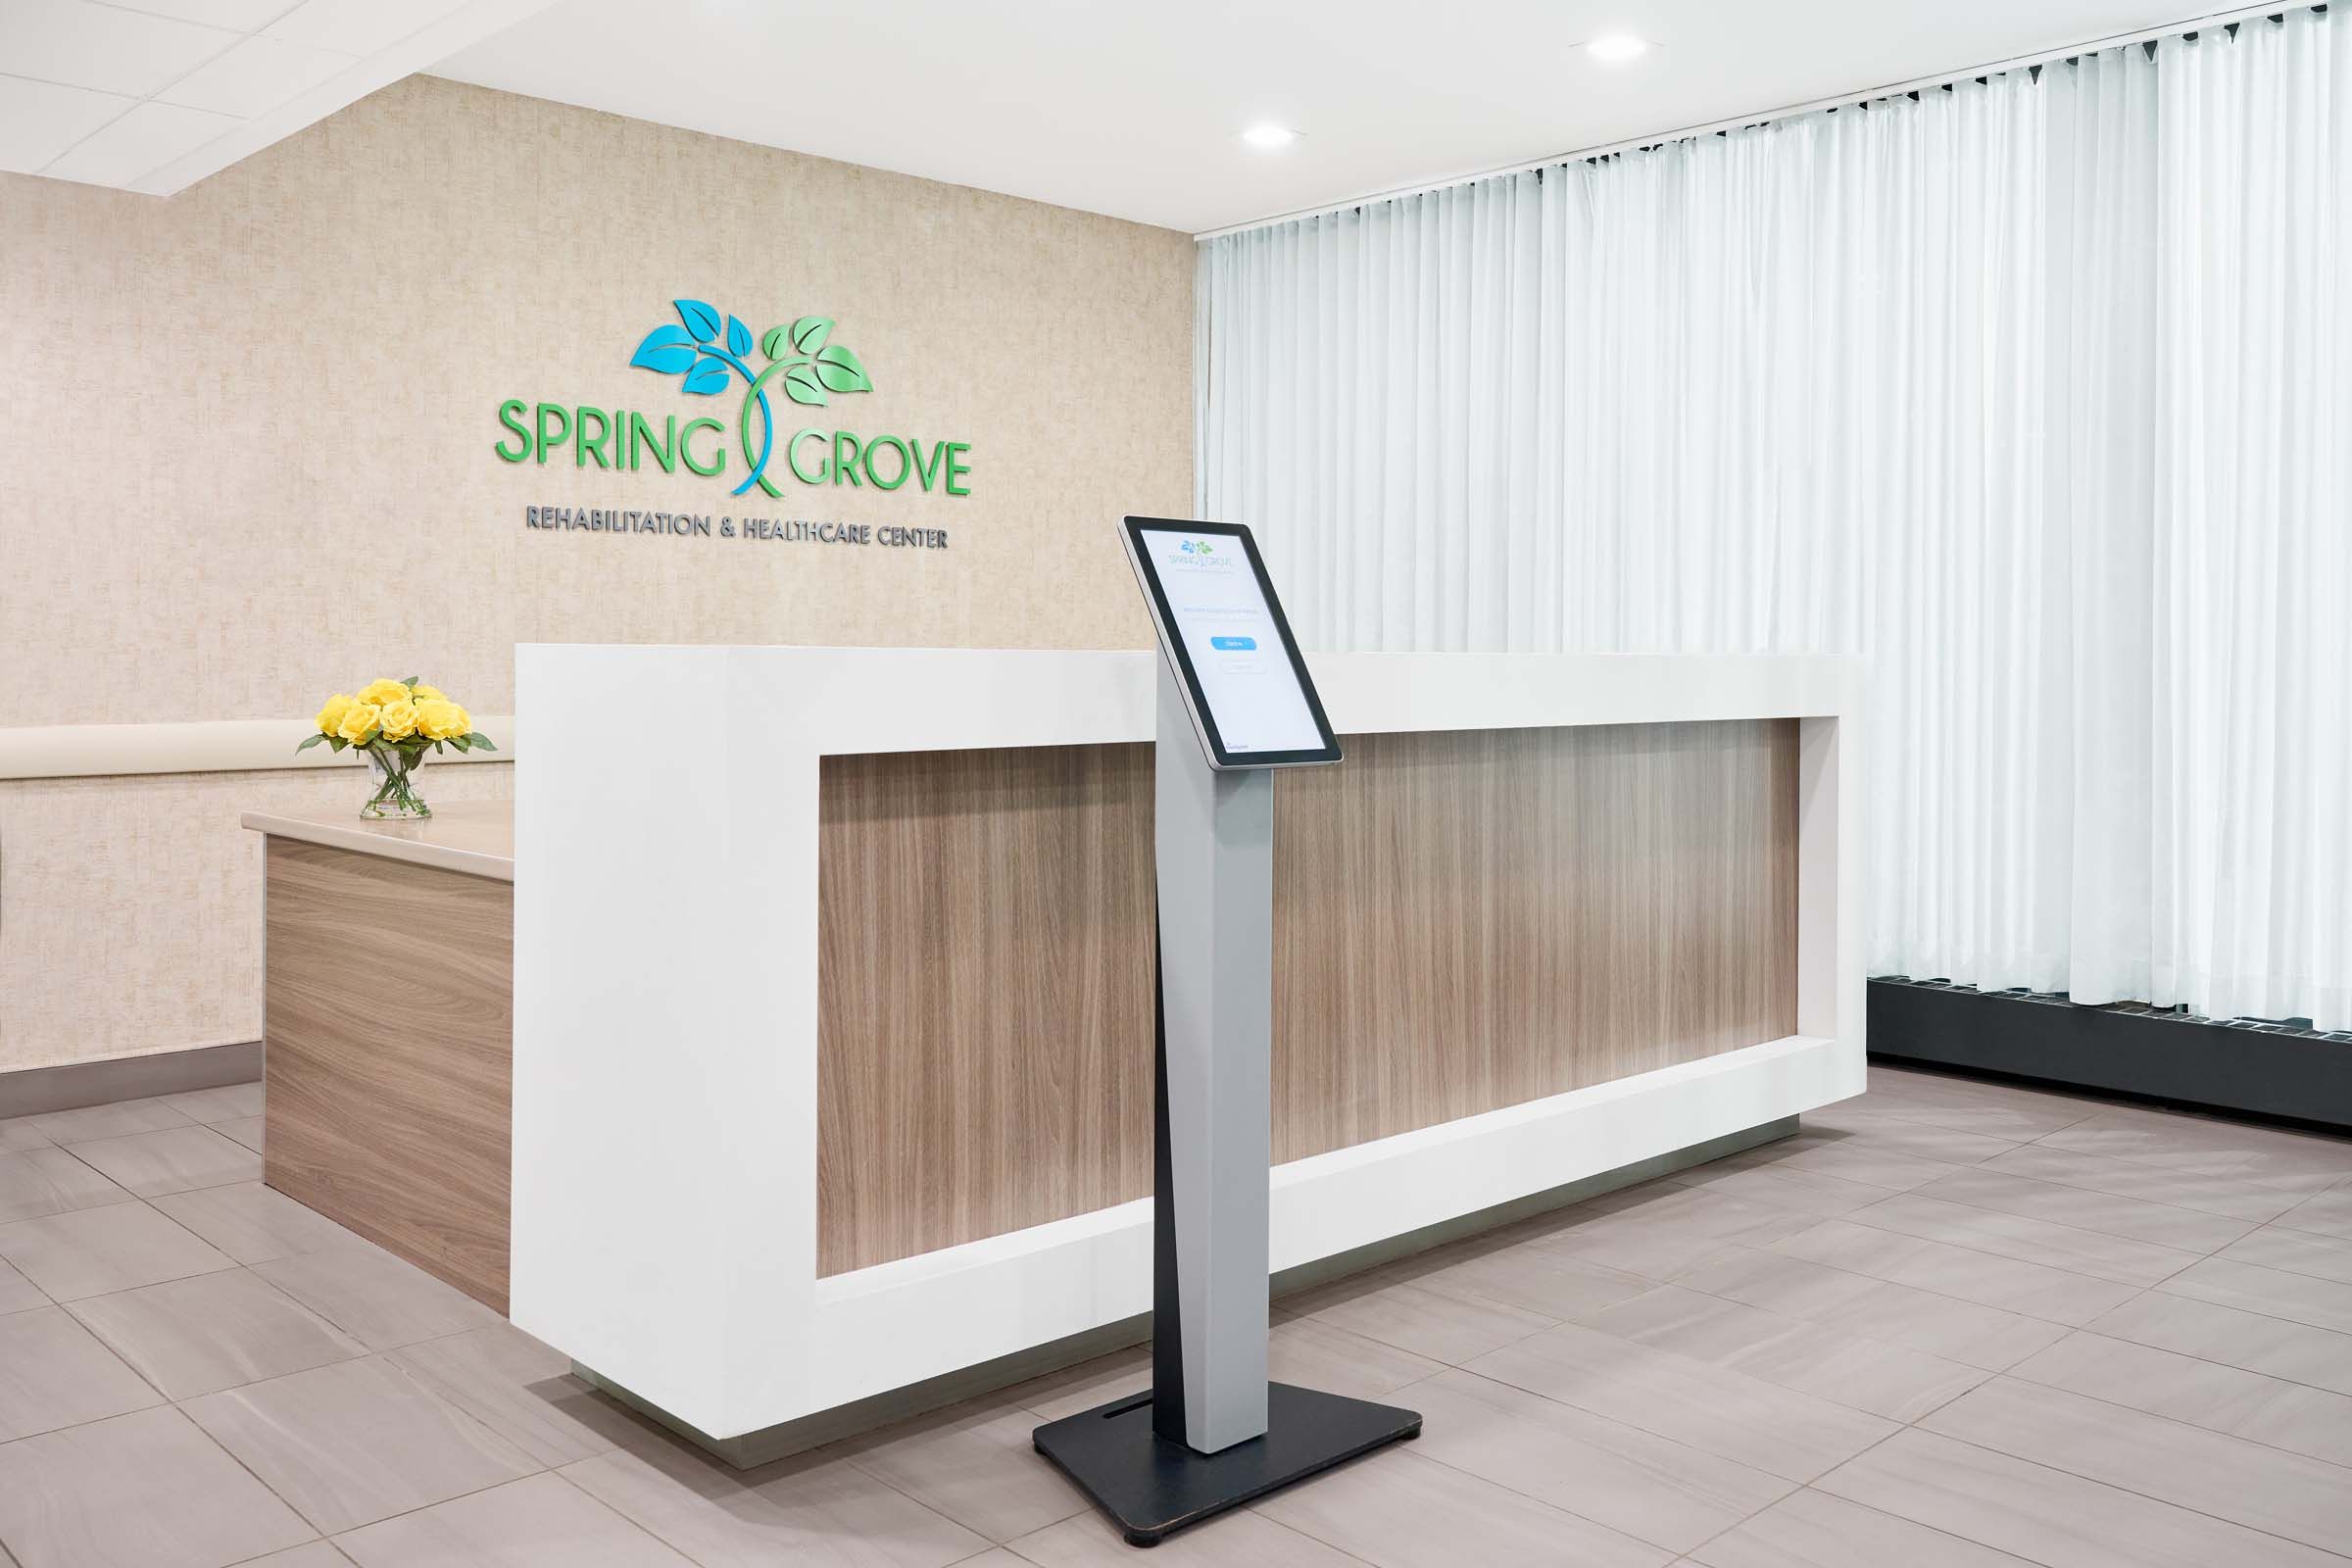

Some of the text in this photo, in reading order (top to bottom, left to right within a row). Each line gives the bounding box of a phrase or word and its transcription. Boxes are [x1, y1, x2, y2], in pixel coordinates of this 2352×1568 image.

[496, 399, 972, 496] SPRING GROVE
[526, 505, 949, 549] REHABILITATION & HEALTHCARE CENTER
